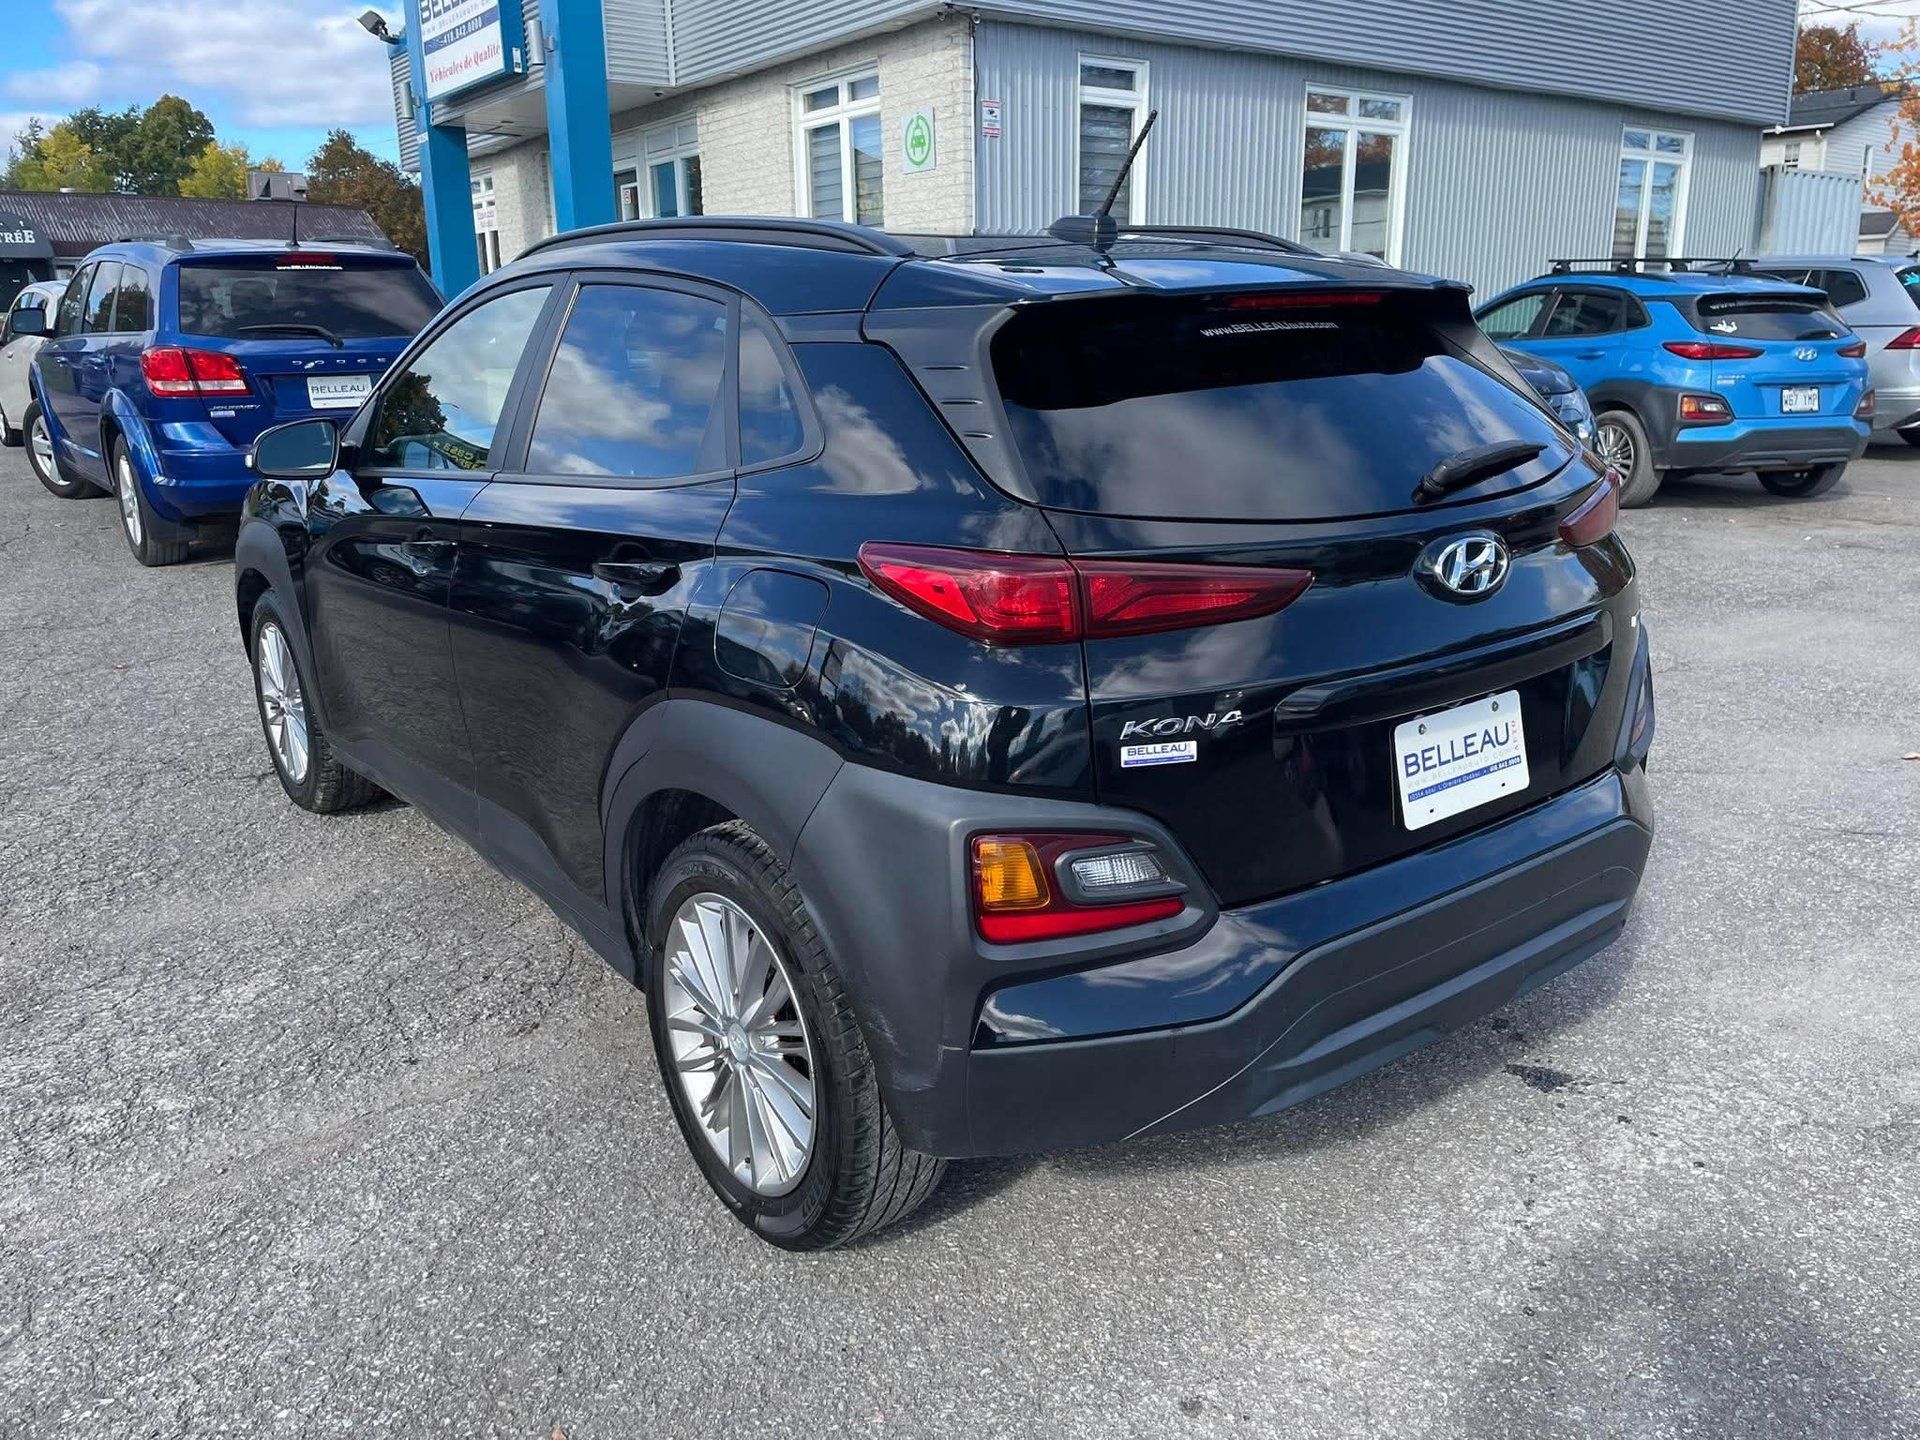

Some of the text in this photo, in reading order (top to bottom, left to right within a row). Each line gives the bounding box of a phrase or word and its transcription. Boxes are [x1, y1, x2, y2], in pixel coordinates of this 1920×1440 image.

[463, 54, 473, 69] de
[473, 43, 500, 65] Qualité
[311, 383, 365, 395] BELLEAU
[1120, 710, 1243, 740] KONA
[1127, 743, 1187, 757] BELLEAU
[1403, 721, 1509, 778] BELLEAU
